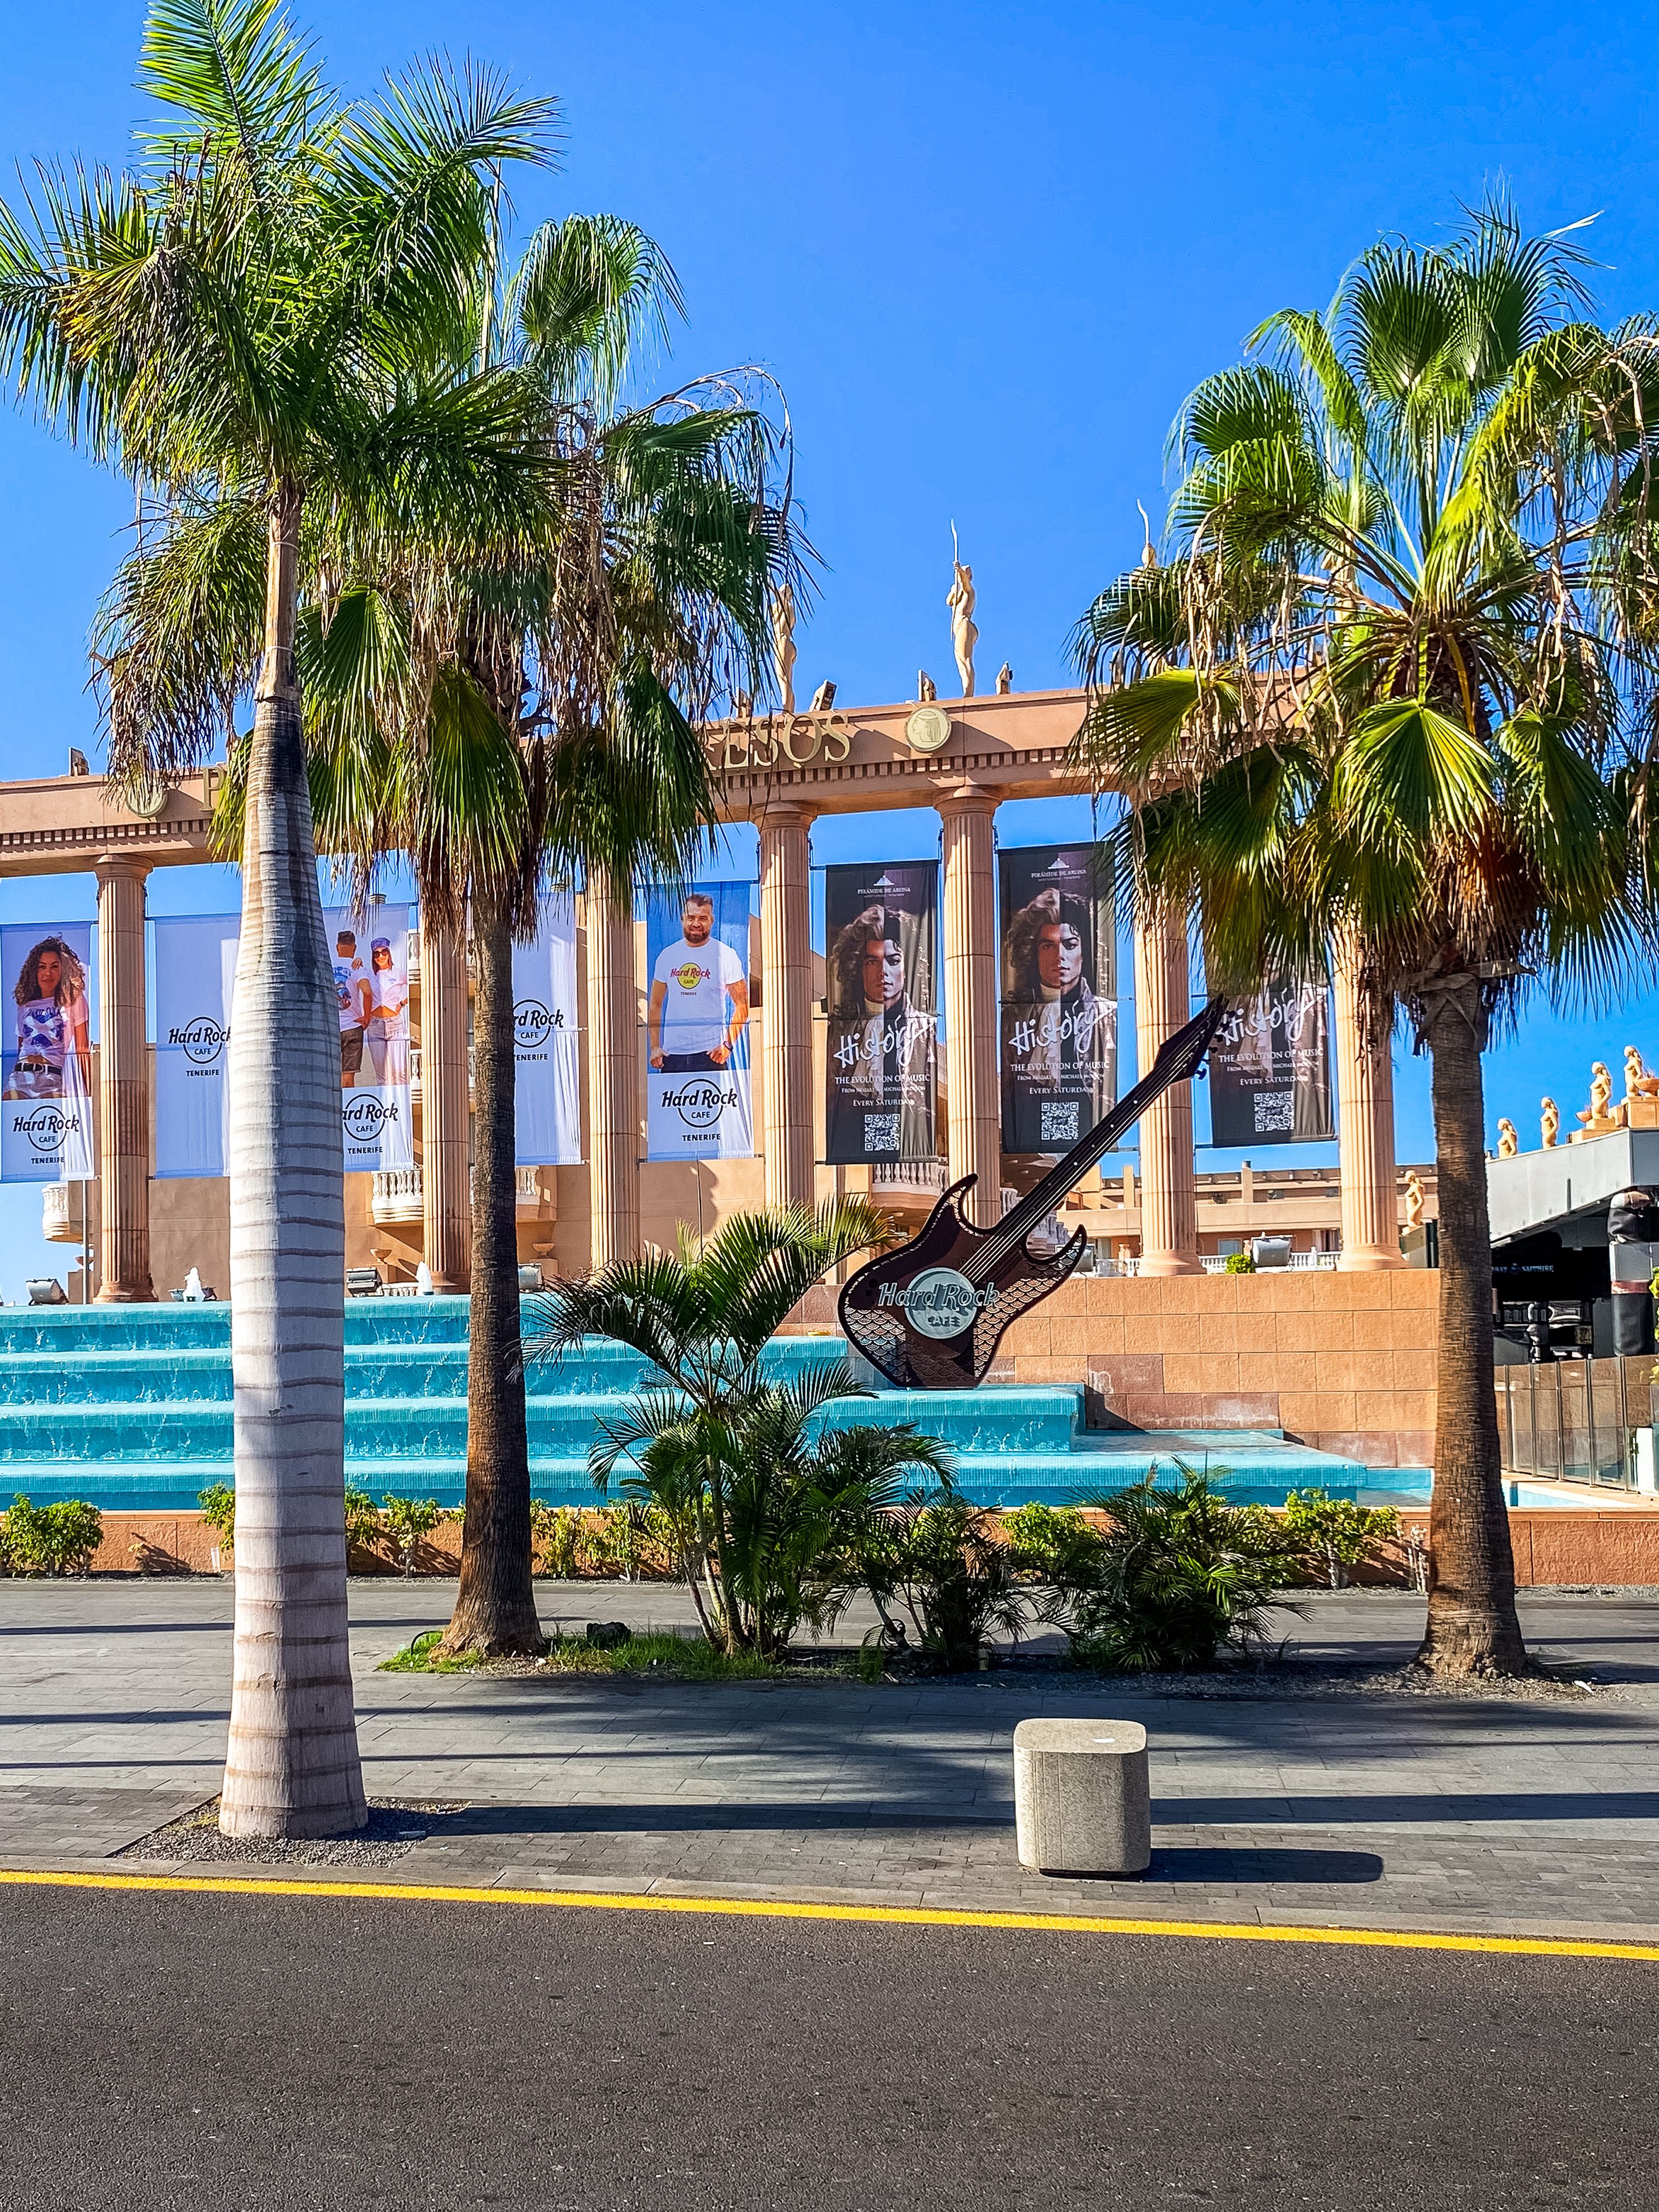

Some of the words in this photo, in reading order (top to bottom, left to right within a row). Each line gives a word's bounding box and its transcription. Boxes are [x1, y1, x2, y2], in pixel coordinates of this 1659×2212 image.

[705, 715, 850, 770] ESOS
[670, 967, 690, 978] Hard
[691, 967, 710, 980] Rock
[529, 1008, 564, 1029] Rock
[168, 1026, 202, 1044] Hard
[1218, 1054, 1235, 1063] THE
[1085, 1060, 1110, 1069] MUSIC
[185, 1069, 219, 1077] TENERIFE
[834, 1076, 850, 1085] THE
[1240, 1077, 1263, 1086] EVERY
[1265, 1075, 1302, 1085] SATURD
[1053, 1086, 1092, 1094] SATURDA
[662, 1089, 700, 1107] Hard
[701, 1087, 738, 1109] Rock
[875, 1098, 913, 1107] SATURDA
[365, 1102, 398, 1123] Rock
[13, 1115, 47, 1132] Hard
[47, 1114, 80, 1133] Rock
[356, 1125, 374, 1133] CAFE
[681, 1133, 721, 1142] TENERIFE
[347, 1146, 383, 1154] TENERIFE
[30, 1156, 65, 1164] TENERIFE
[878, 1282, 941, 1308] Hard
[941, 1282, 1000, 1312] Rock
[927, 1316, 960, 1327] CAFE
